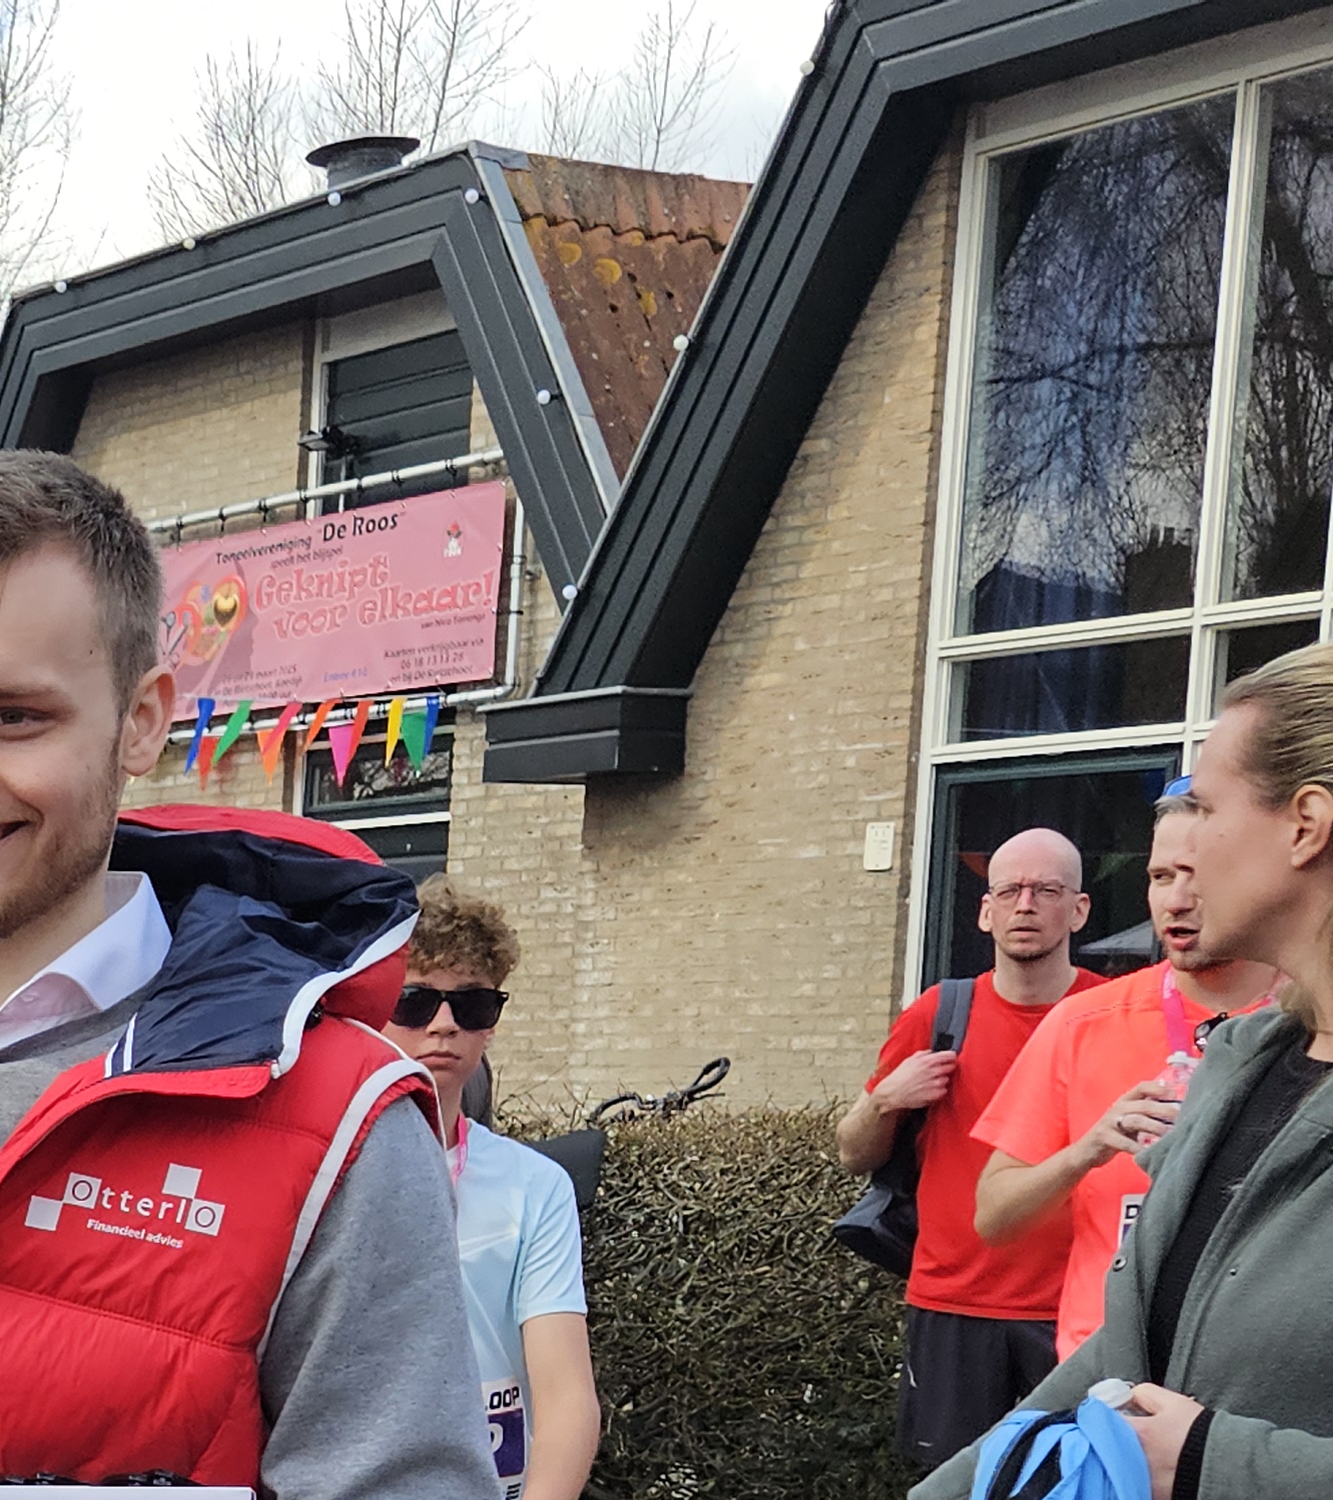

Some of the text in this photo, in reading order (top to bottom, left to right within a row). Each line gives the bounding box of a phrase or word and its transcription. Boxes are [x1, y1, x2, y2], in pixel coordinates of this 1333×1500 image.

[255, 555, 390, 610] Geknipt
[273, 571, 495, 640] voor elkaar!
[86, 1218, 184, 1249] Financieel advies
